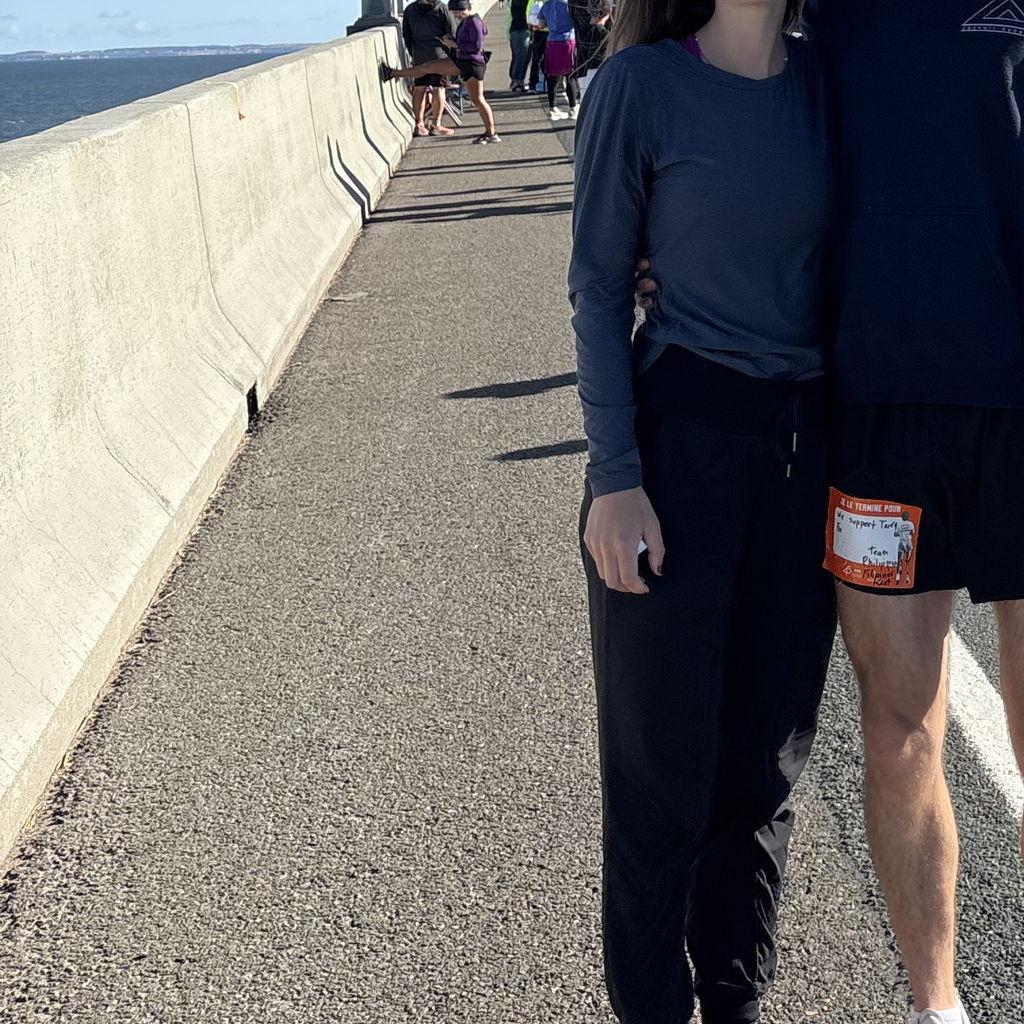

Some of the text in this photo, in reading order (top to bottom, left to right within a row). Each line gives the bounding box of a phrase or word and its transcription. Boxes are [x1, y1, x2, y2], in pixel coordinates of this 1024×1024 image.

[846, 500, 853, 509] LE
[855, 502, 882, 513] TERMINE
[884, 505, 902, 513] POUR
